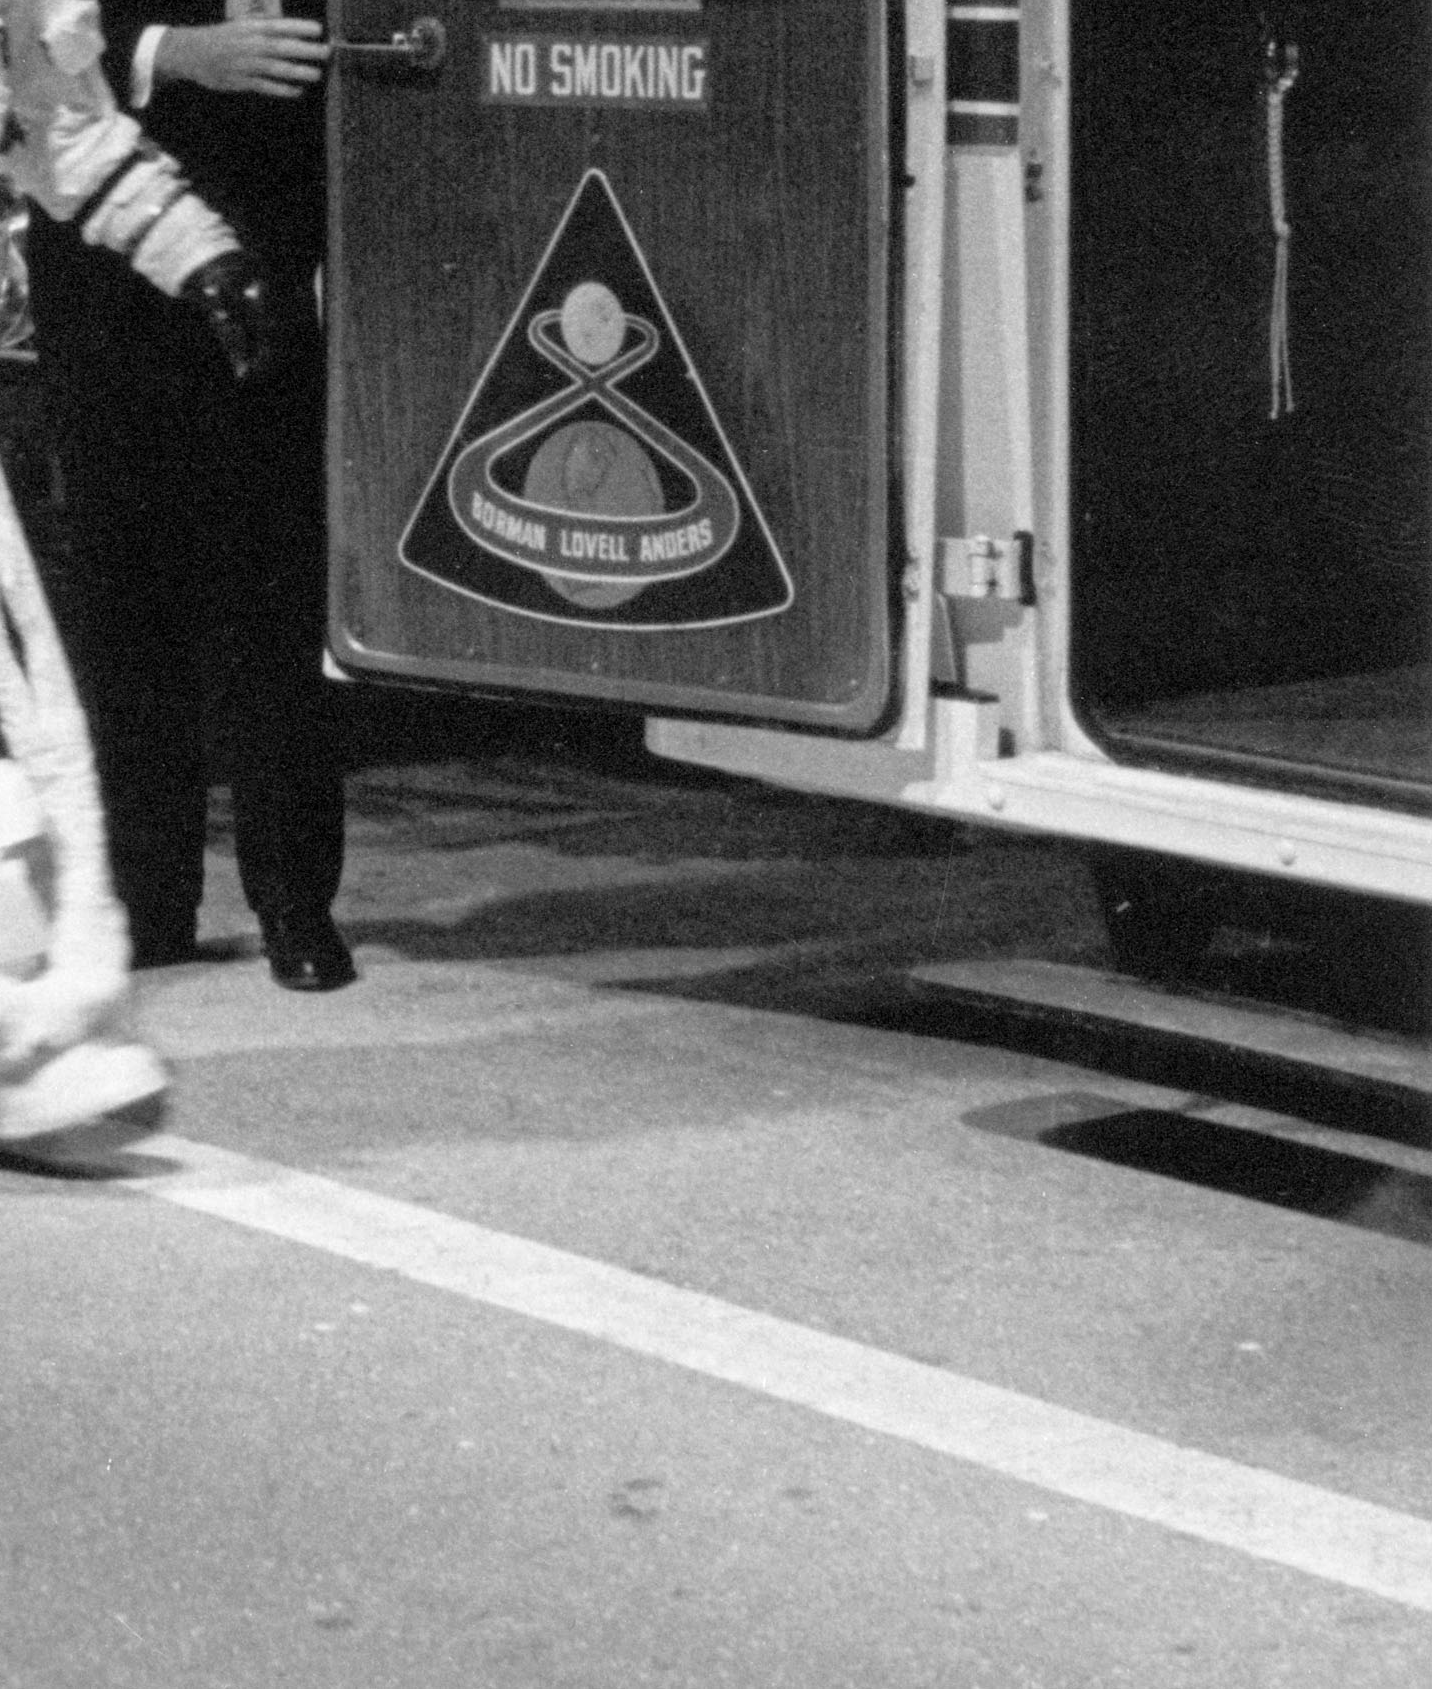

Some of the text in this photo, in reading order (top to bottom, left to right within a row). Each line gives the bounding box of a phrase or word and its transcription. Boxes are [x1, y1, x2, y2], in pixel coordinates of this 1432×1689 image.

[490, 42, 706, 99] NO SMOKING
[471, 490, 713, 562] BORMAN LOVELL ANDERS
